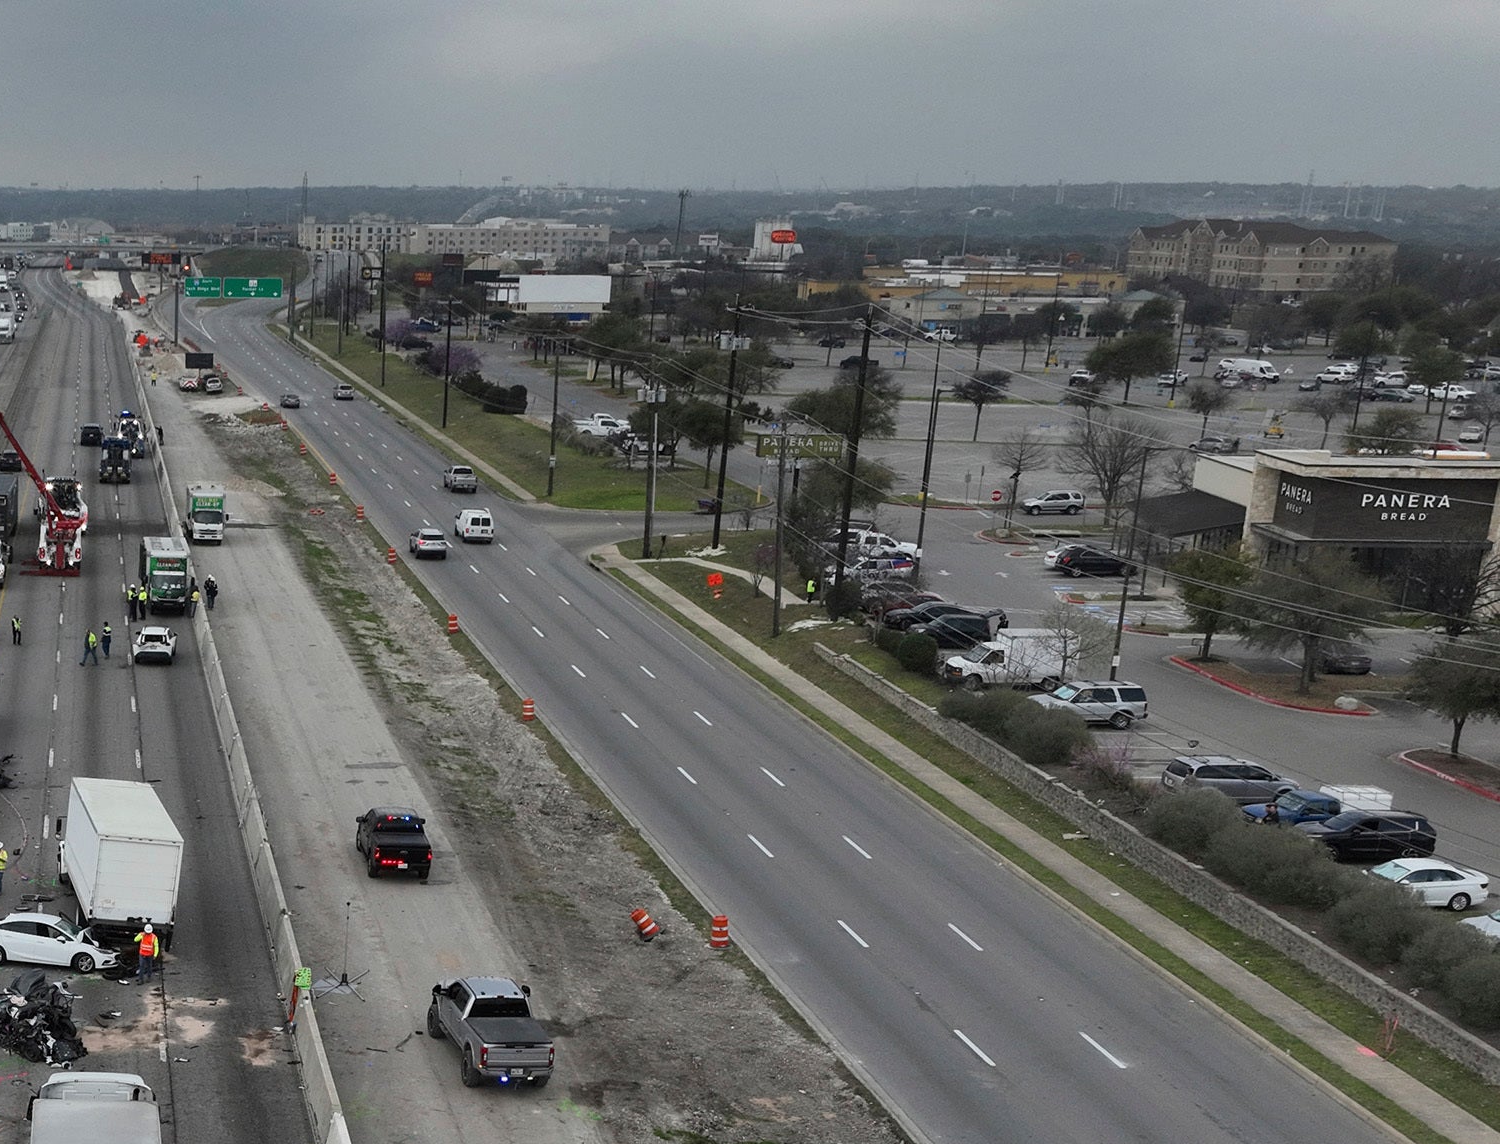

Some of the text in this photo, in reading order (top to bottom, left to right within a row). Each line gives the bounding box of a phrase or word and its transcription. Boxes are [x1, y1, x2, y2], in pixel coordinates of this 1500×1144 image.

[1280, 482, 1312, 504] PANERA
[1361, 494, 1451, 508] PANERA
[1285, 502, 1303, 515] BREAD
[1381, 512, 1428, 521] BREAD
